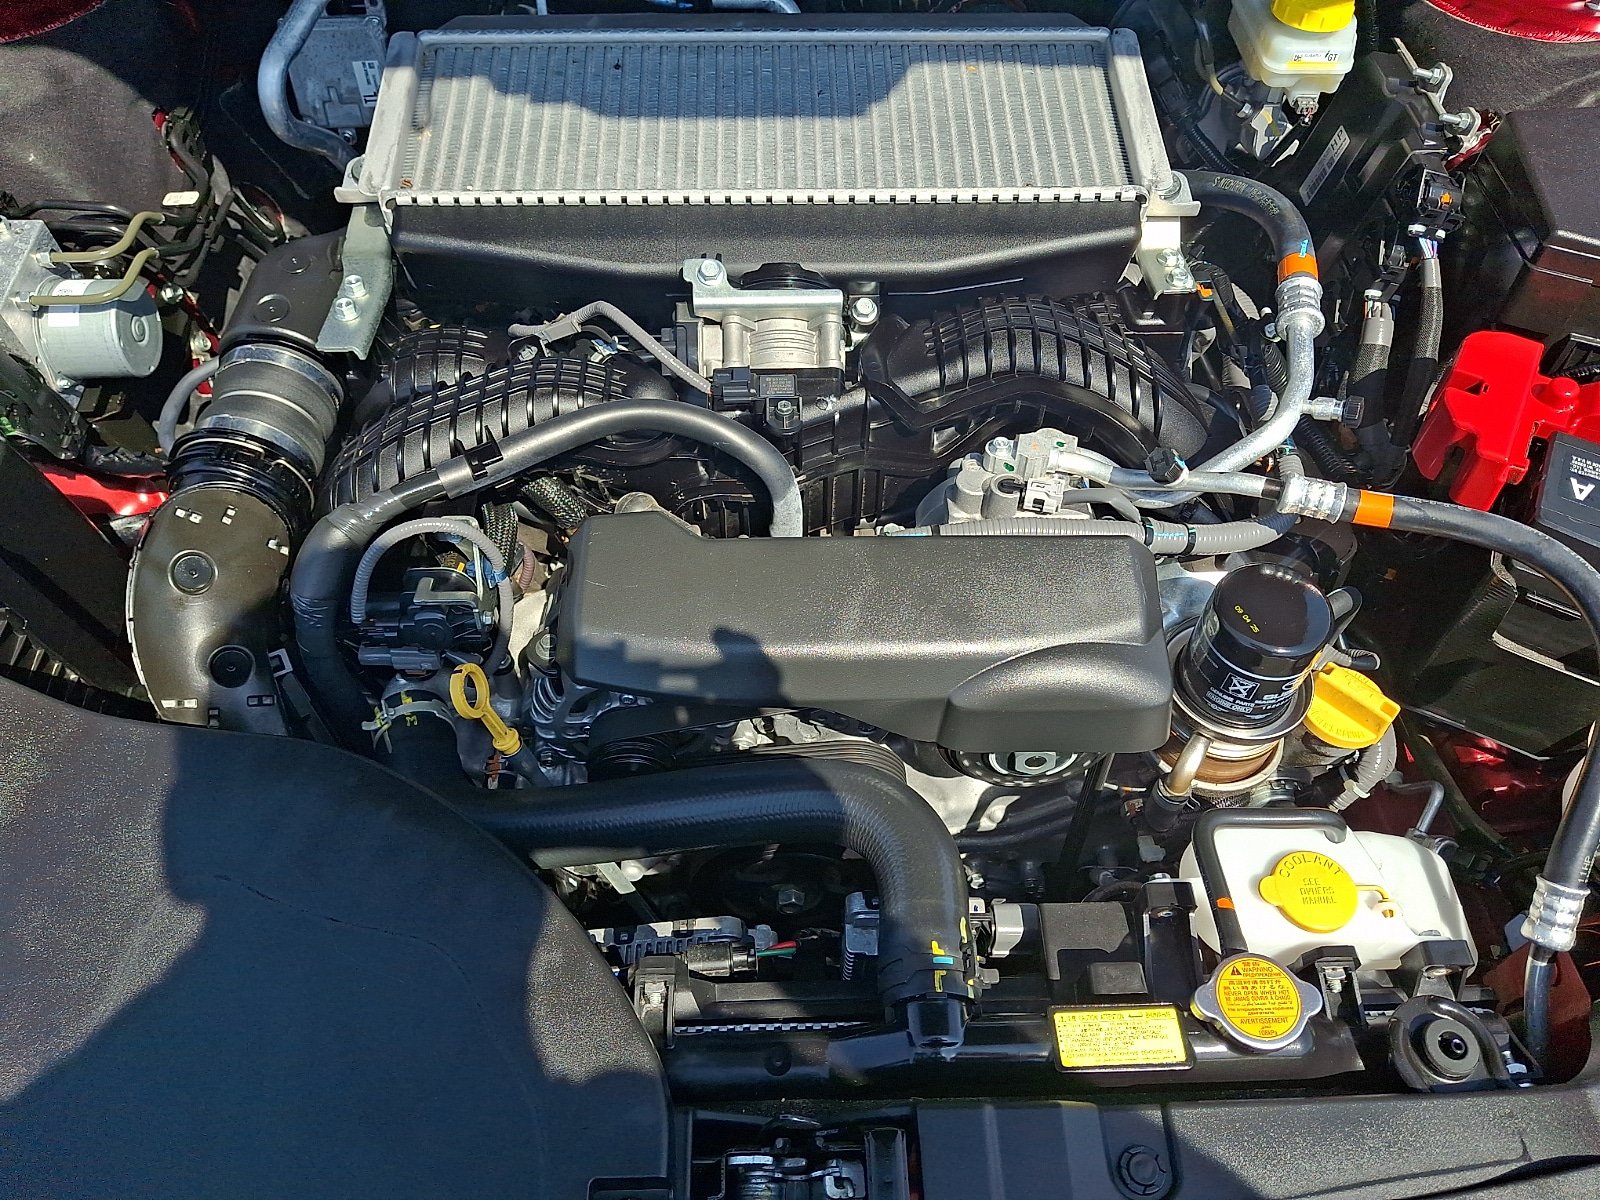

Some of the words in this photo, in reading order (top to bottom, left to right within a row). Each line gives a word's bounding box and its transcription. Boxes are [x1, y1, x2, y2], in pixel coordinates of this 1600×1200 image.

[1235, 699, 1256, 708] PARTS
[1279, 853, 1344, 878] COOLANT
[1302, 877, 1321, 886] SEE
[1302, 896, 1337, 905] MANUAL
